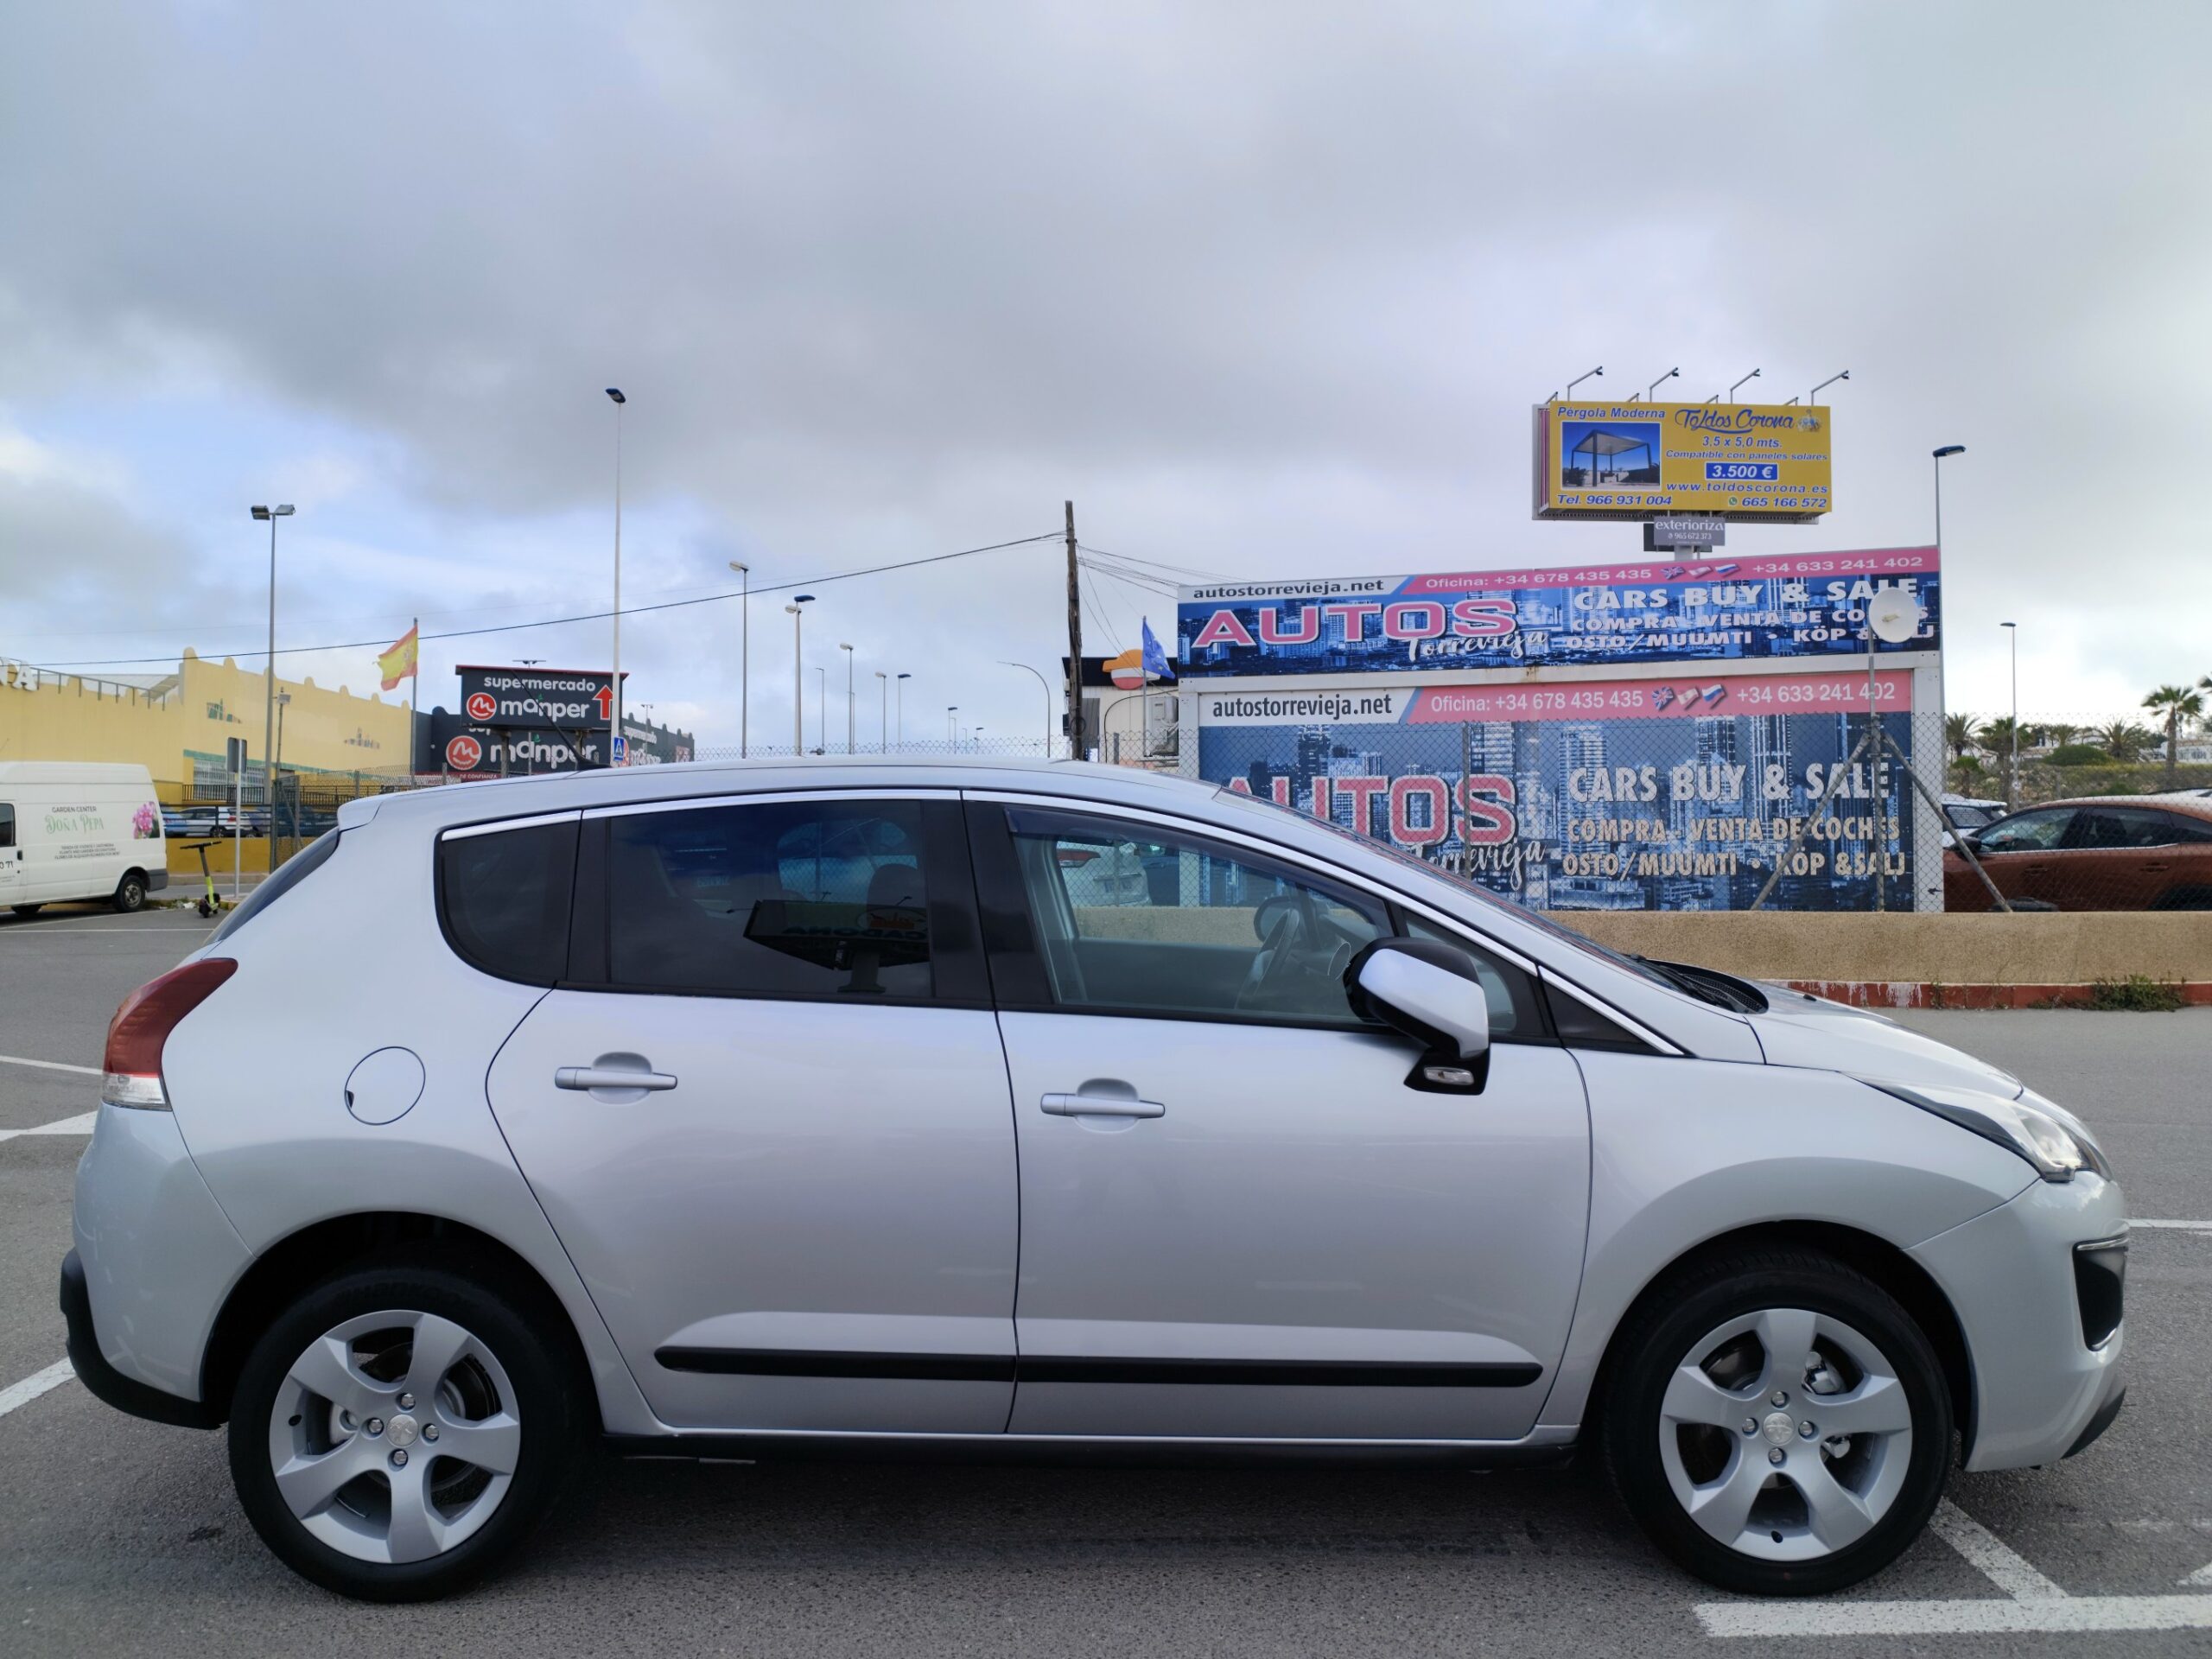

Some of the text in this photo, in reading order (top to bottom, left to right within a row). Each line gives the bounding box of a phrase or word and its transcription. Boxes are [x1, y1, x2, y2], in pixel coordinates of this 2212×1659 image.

[1557, 407, 1666, 420] Pérgola Moderna
[1675, 409, 1794, 434] Toldos Corona
[1757, 438, 1783, 448] mts.
[1666, 449, 1723, 460] Compatible
[1749, 452, 1788, 461] paneles
[1791, 452, 1827, 461] solares
[1712, 465, 1758, 478] 3.500
[1666, 482, 1828, 493] www.toldoscorona.es
[1558, 494, 1672, 505] Tel. 966 931 004
[1742, 497, 1827, 508] 665 166 572
[1655, 519, 1724, 531] exterioriza
[1753, 556, 1923, 574] +34 633 241 402
[1427, 569, 1652, 588] Oficina: +34 678 435 435
[1193, 579, 1384, 600] autostorrevieja.net
[1573, 588, 1669, 611] CARS
[1684, 584, 1764, 607] BUY
[1781, 582, 1810, 603] &
[1191, 598, 1518, 648] AUTOS
[1572, 614, 1677, 632] COMPRA
[1700, 610, 1781, 627] VENTA
[1791, 610, 1822, 624] DE
[1794, 625, 1847, 642] KÖP
[1401, 630, 1549, 663] Torrevieja
[484, 676, 596, 691] supermercado
[1737, 685, 1773, 703] +34
[1777, 684, 1814, 702] 633
[1819, 683, 1854, 702] 241
[500, 698, 590, 723] manper
[1212, 694, 1392, 721] autostorrevieja.net
[1431, 690, 1643, 713] Oficina: +34 678 435 435
[1568, 762, 1890, 803] CARS BUY & SALE
[1567, 818, 1667, 842] COMPRA
[1689, 817, 1763, 841] VENTA
[1773, 817, 1802, 841] DE
[1562, 851, 1738, 881] OSTO/MUUMTI
